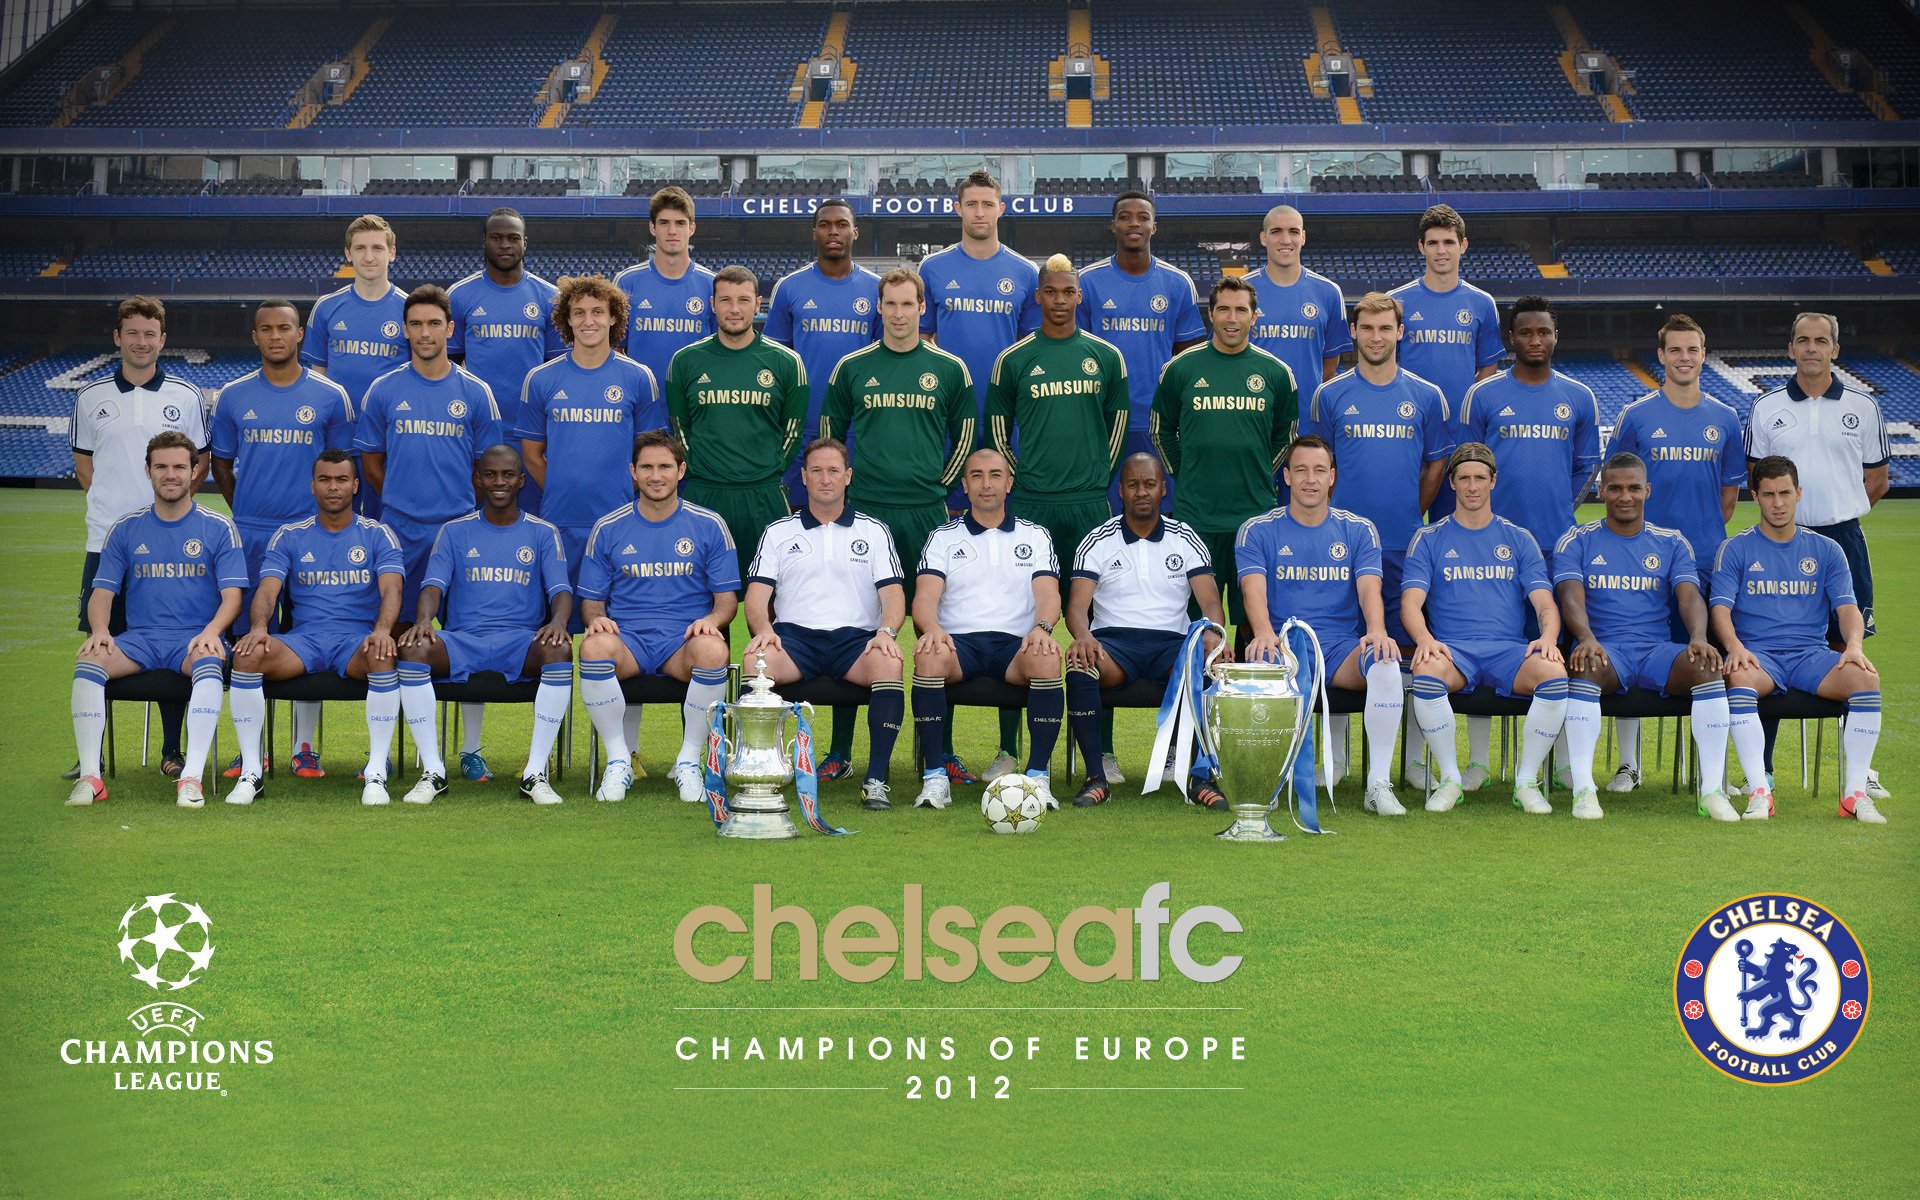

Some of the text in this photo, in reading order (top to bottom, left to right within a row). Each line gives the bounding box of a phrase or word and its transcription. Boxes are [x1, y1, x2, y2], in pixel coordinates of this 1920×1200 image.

[743, 198, 1073, 214] CHELS FOOTB CLUB
[945, 297, 1012, 315] SAMSUNG
[635, 317, 702, 333] SAMSUNG
[802, 318, 868, 334] SAMSUNG
[1102, 318, 1164, 331] SAMSUNG
[1252, 325, 1316, 339] SAMSUNG
[1408, 329, 1472, 344] SAMSUNG
[332, 339, 399, 357] SAMSUNG
[1031, 380, 1100, 398] SAMSUNG
[698, 390, 771, 406] SAMSUNG
[864, 393, 935, 410] SAMSUNG
[1193, 396, 1265, 411] SAMSUNG
[553, 408, 622, 423] SAMSUNG
[396, 419, 464, 437] SAMSUNG
[1345, 424, 1414, 439] SAMSUNG
[1500, 424, 1569, 440] SAMSUNG
[244, 429, 313, 444] SAMSUNG
[135, 563, 206, 578] SAMSUNG
[299, 569, 370, 585] SAMSUNG
[466, 567, 530, 585] SAMSUNG
[622, 562, 693, 577] SAMSUNG
[1277, 565, 1349, 581] SAMSUNG
[1443, 566, 1514, 581] SAMSUNG
